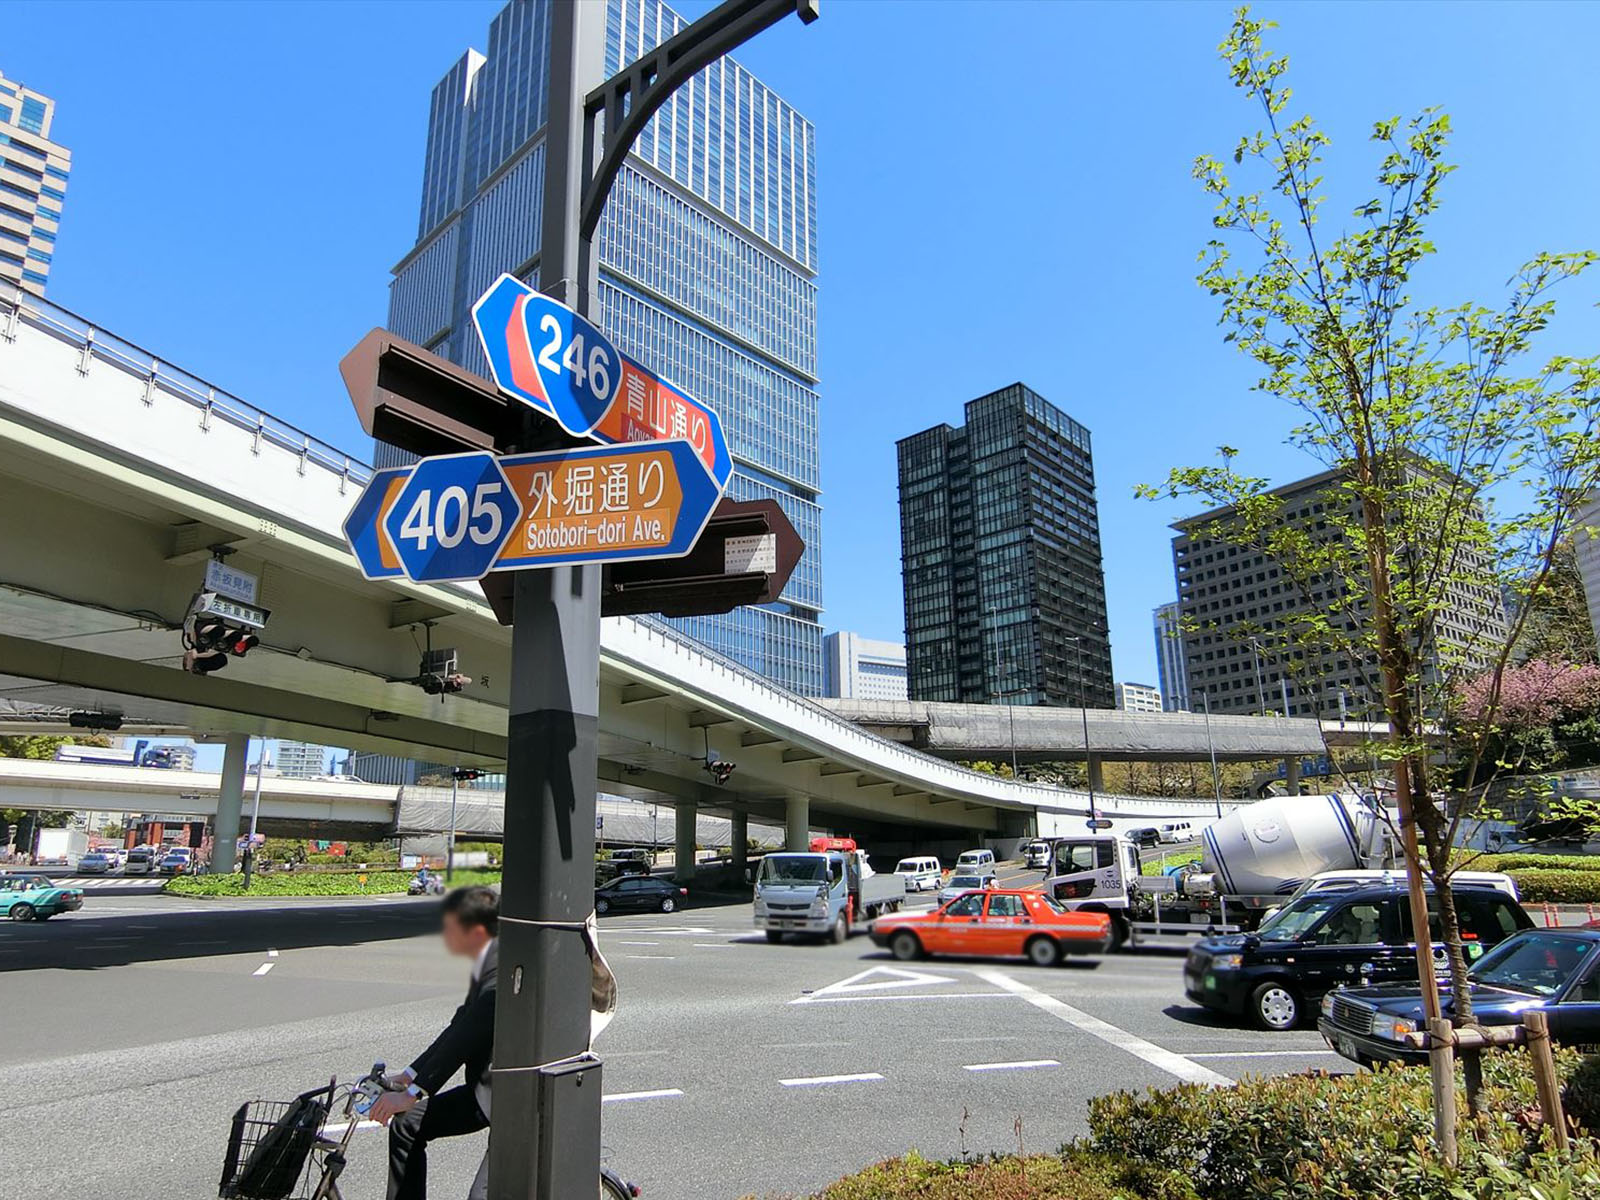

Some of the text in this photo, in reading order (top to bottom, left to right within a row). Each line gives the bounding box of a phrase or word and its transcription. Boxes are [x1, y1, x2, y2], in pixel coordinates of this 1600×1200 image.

[538, 313, 610, 402] 246
[626, 373, 706, 453] 青山通り
[400, 482, 503, 551] 405
[528, 459, 665, 518] 外堀通り
[527, 515, 665, 550] Sotobori-dori Ave.
[1101, 879, 1121, 889] 1035
